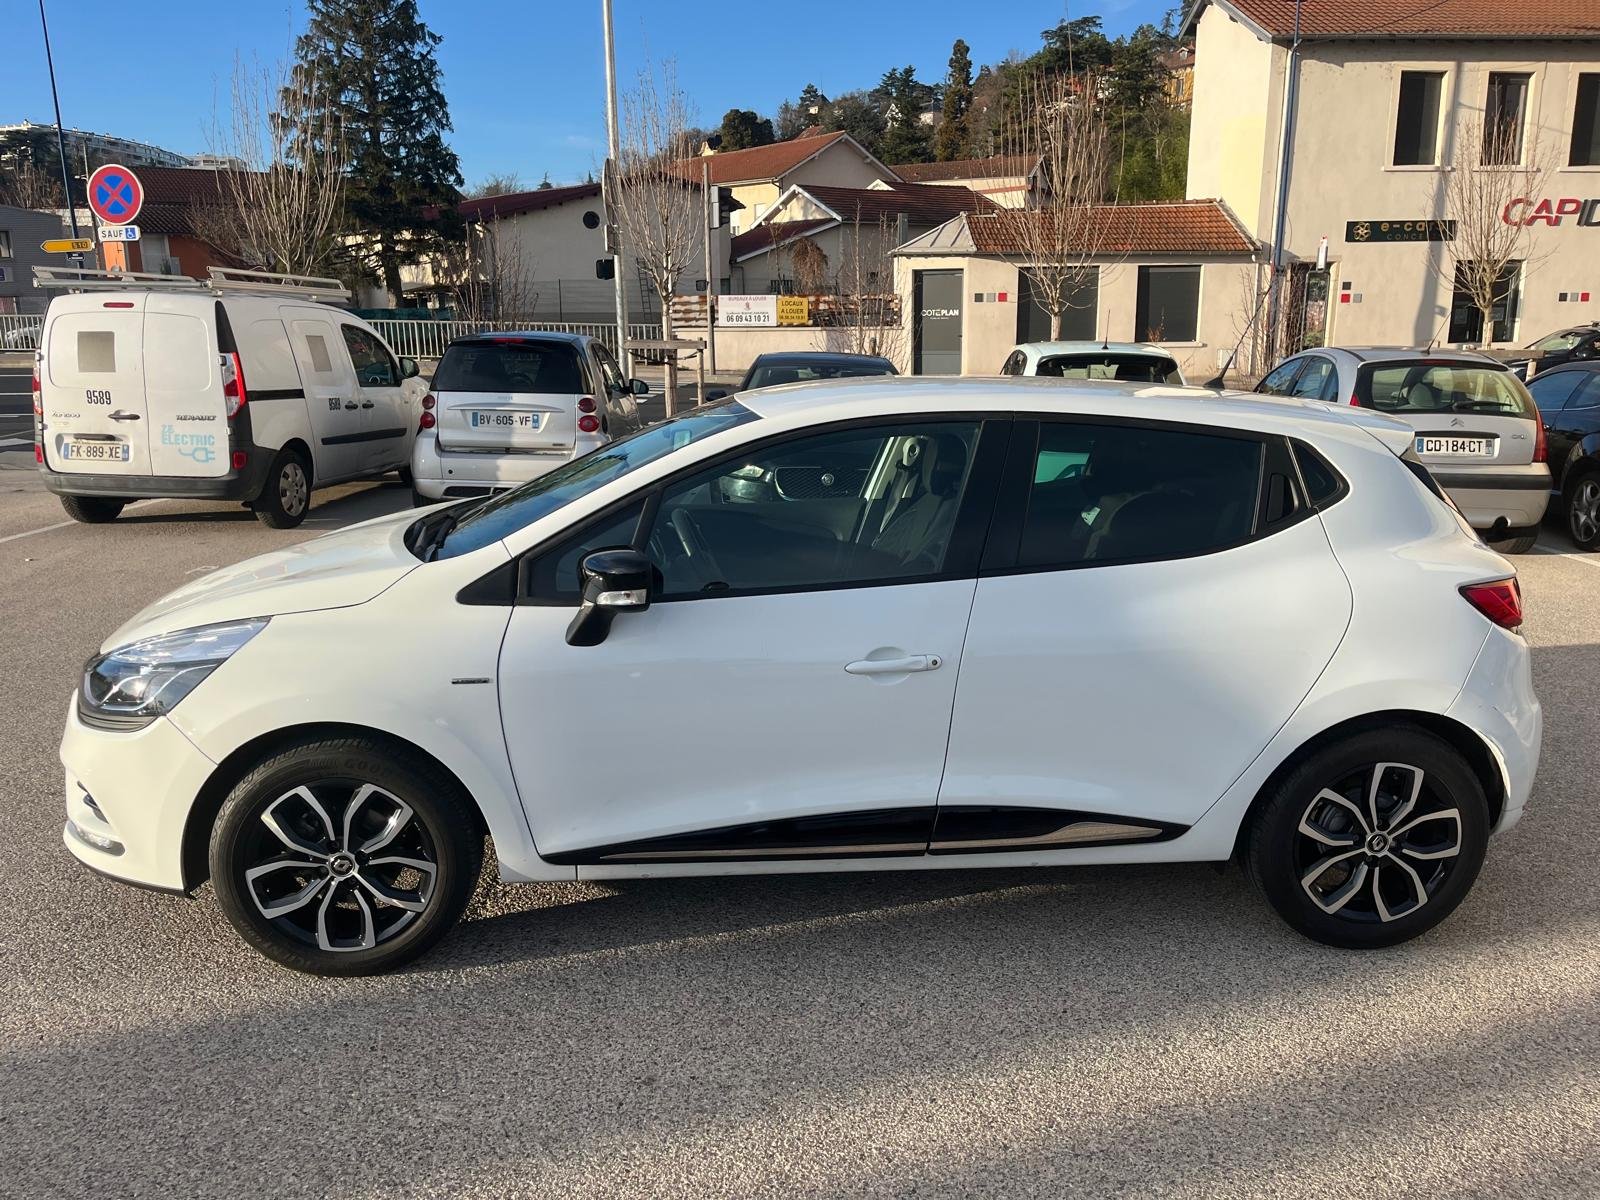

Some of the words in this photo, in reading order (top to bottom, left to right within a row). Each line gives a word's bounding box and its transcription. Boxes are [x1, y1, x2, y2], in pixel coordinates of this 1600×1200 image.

[101, 230, 123, 238] SAUF
[86, 389, 112, 405] 9589
[161, 433, 215, 446] ELECTRIC
